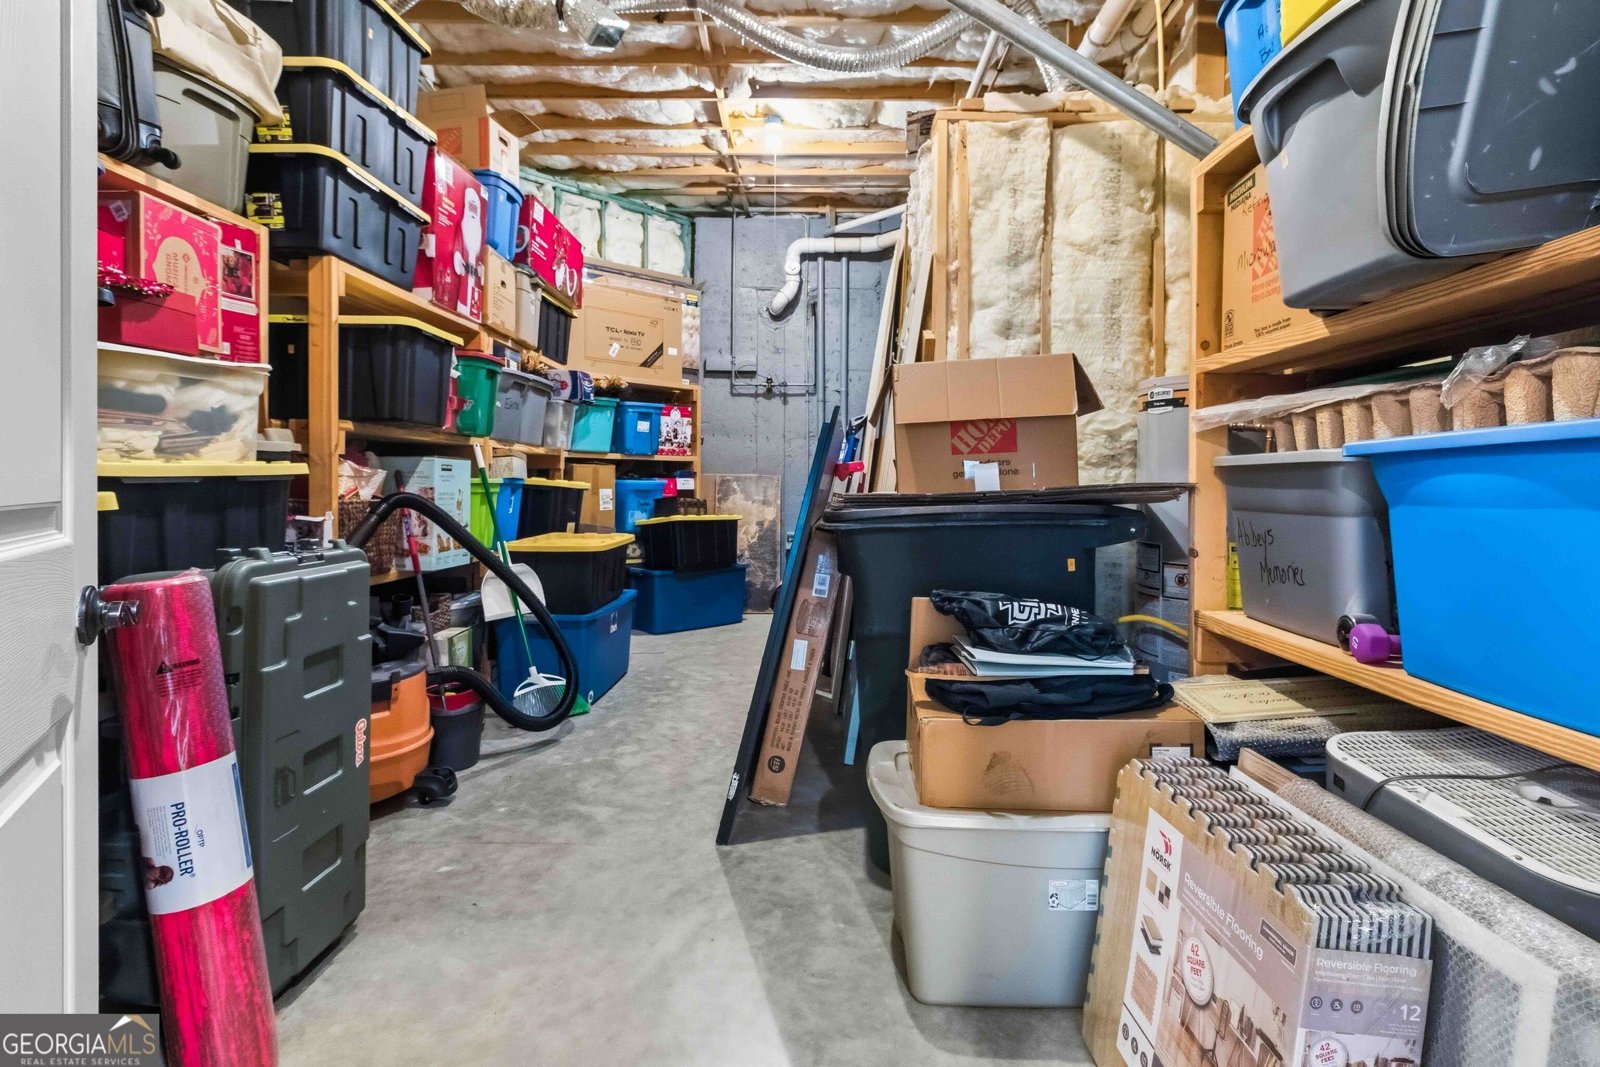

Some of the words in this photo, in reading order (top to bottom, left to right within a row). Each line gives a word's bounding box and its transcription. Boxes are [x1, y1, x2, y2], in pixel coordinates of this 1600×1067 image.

[1229, 179, 1255, 203] MEDIUM
[605, 326, 620, 334] TCL
[1260, 562, 1306, 587] Memories
[196, 829, 205, 848] OPTP
[1184, 872, 1225, 919] Reversible
[1226, 913, 1264, 961] Flooring
[1191, 943, 1200, 957] 42
[1316, 958, 1372, 972] Reversible
[1374, 963, 1417, 978] Flooring
[1400, 1004, 1421, 1022] 12
[1315, 1048, 1338, 1060] SQUARE
[1320, 1043, 1330, 1051] 42
[1321, 1055, 1335, 1063] FEET
